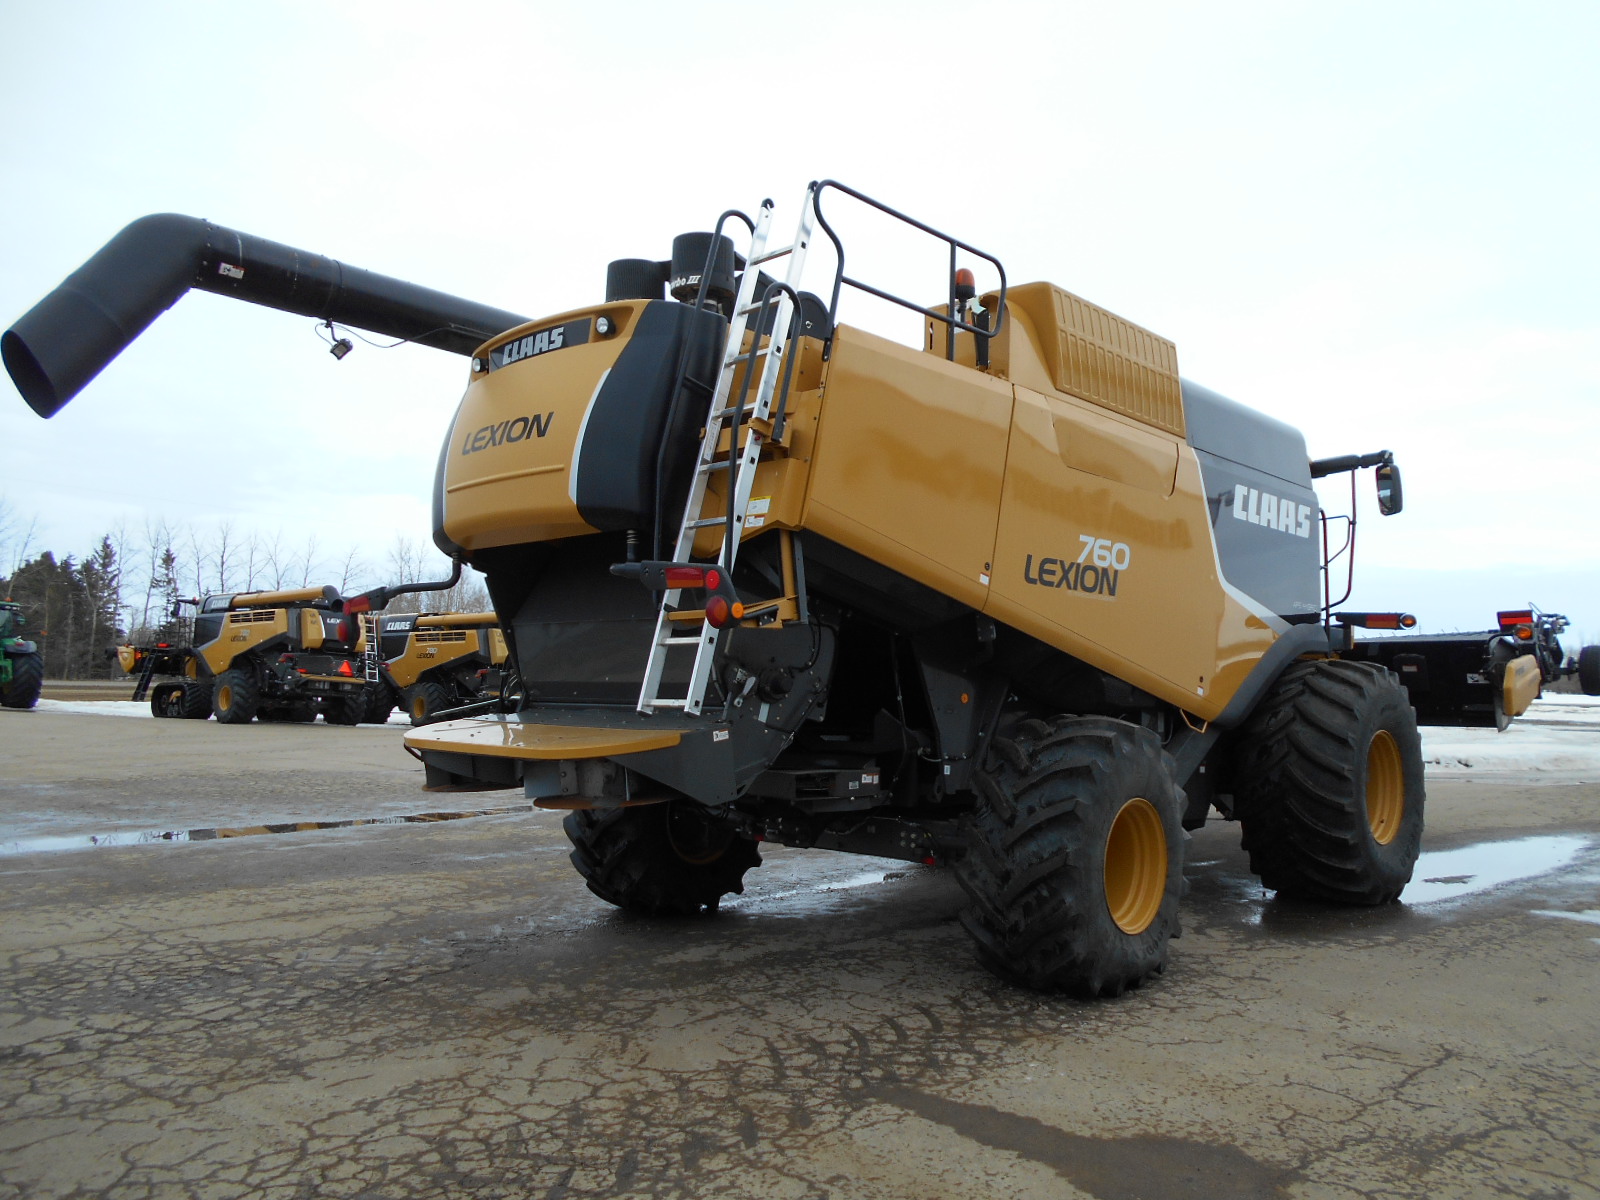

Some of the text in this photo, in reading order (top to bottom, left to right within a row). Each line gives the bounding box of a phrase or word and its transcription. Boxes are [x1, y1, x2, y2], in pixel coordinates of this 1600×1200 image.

[502, 326, 564, 366] CLAAS
[462, 411, 554, 456] LEXION
[1233, 483, 1311, 539] CLAAS
[1077, 534, 1130, 571] 760
[1024, 554, 1119, 597] LEXION
[386, 621, 411, 631] CLAAS
[416, 652, 436, 660] LEXION
